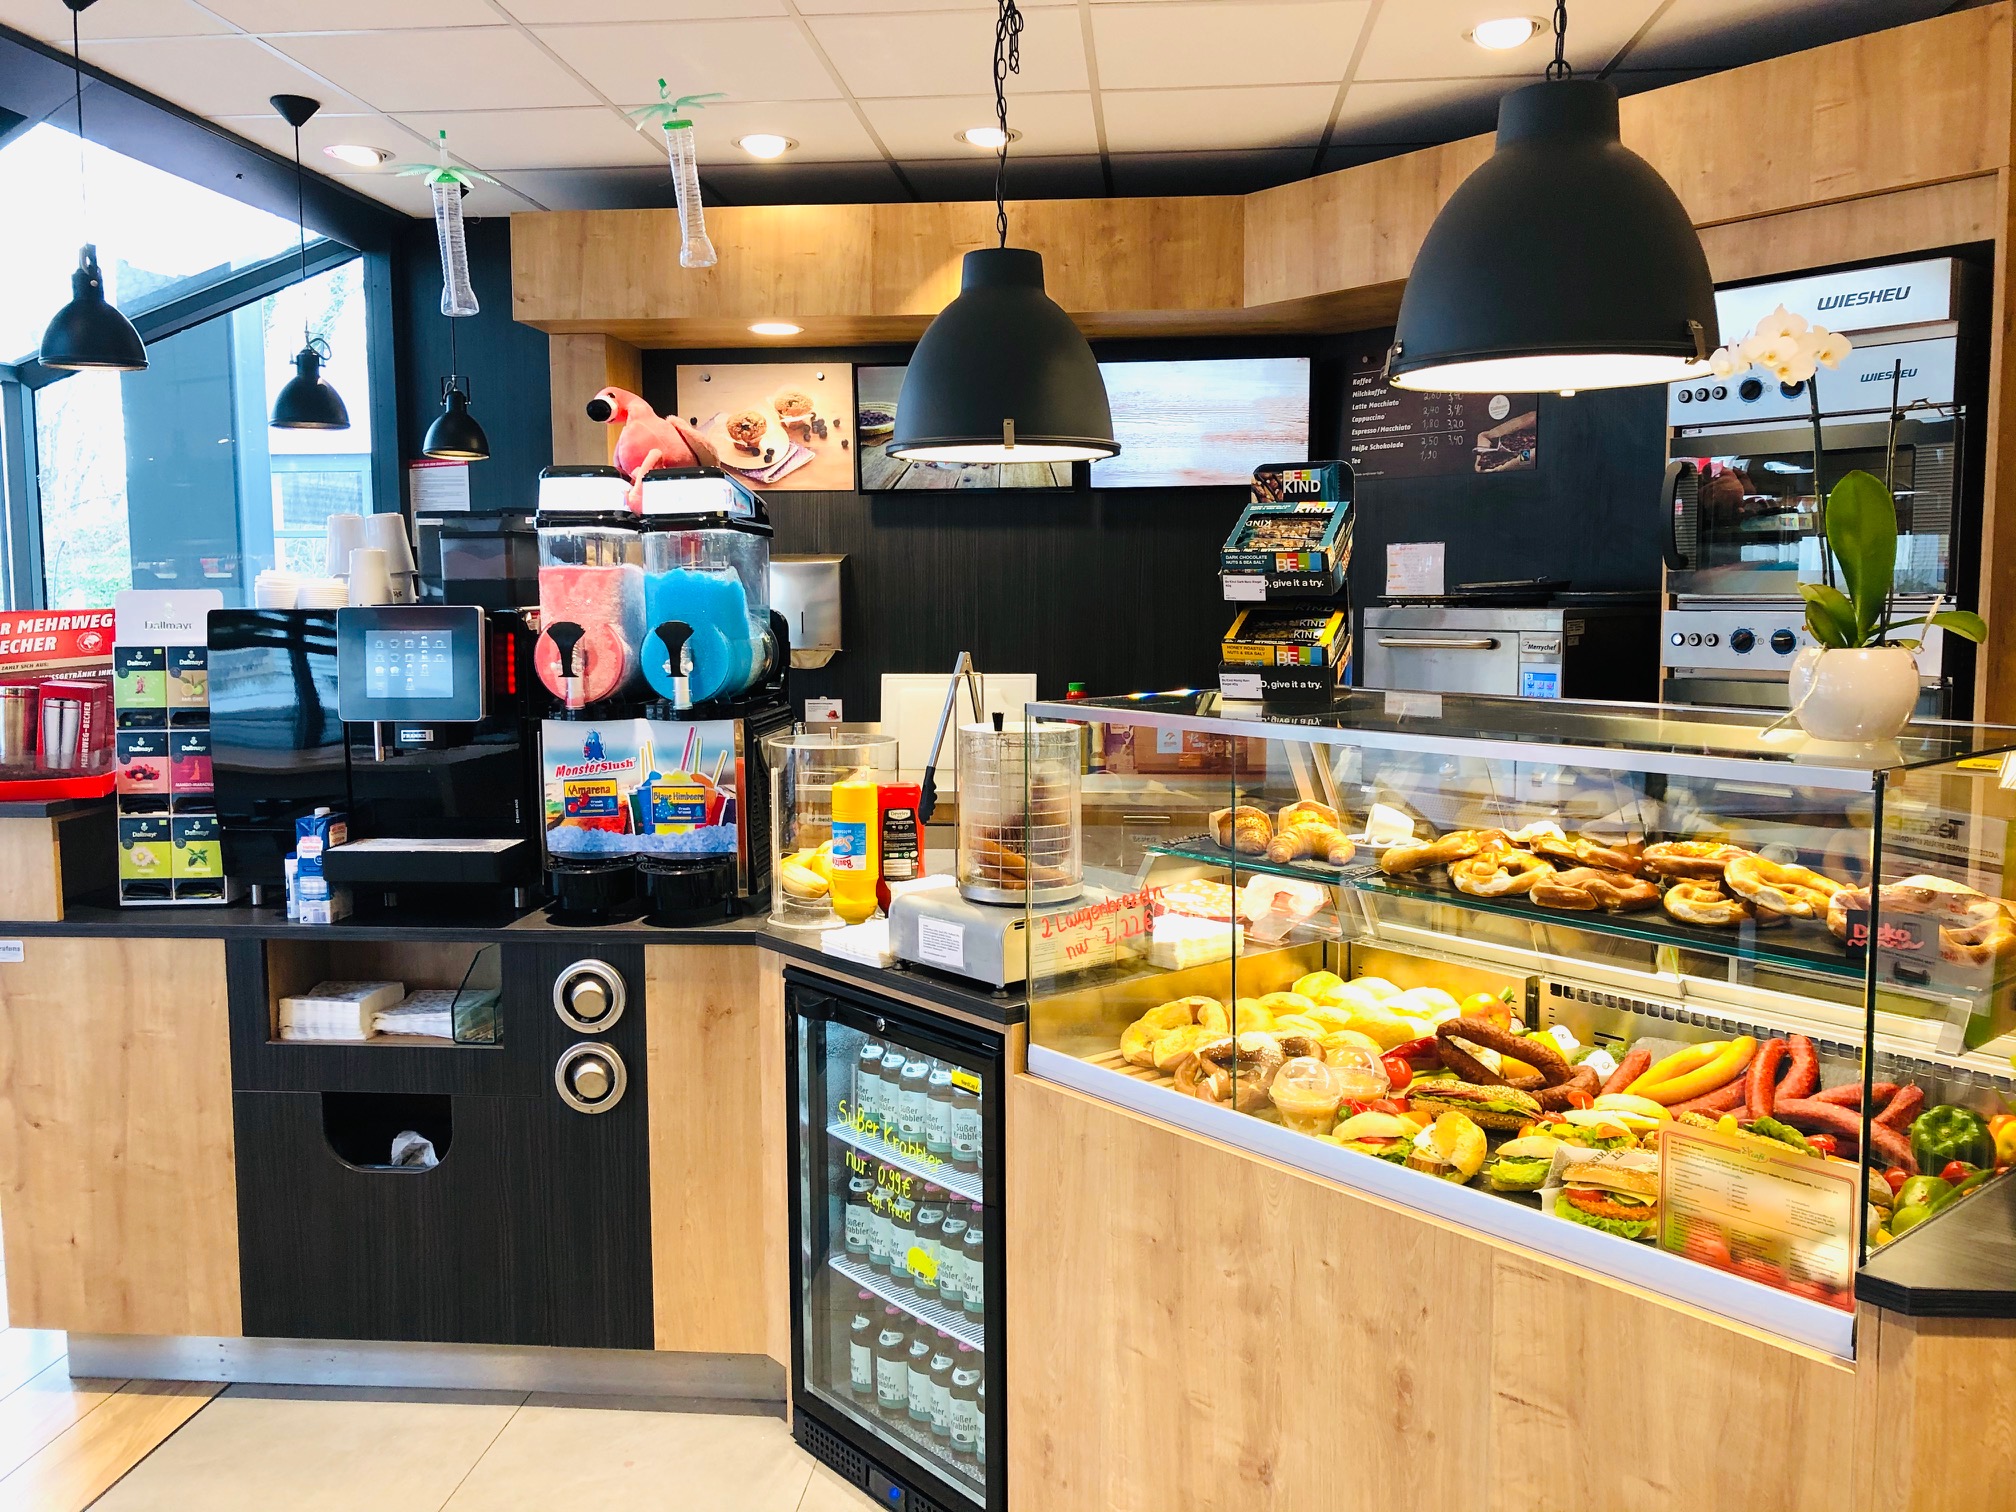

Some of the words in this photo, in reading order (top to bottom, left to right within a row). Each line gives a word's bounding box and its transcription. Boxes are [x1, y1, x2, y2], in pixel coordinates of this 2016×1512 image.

[1817, 286, 1911, 311] WIESHEU
[1352, 403, 1368, 411] Latte
[1369, 441, 1404, 451] Schokolade
[1283, 480, 1321, 494] KIND
[1276, 558, 1305, 571] BE-
[1273, 579, 1292, 588] give
[1310, 579, 1324, 588] try.
[144, 621, 192, 630] Dallmayr
[0, 637, 58, 654] ECHER
[1528, 643, 1556, 652] Merrychef
[1277, 651, 1305, 664] BE-
[39, 670, 97, 680] SSGETRÄNKE
[1271, 681, 1290, 690] give
[1291, 680, 1298, 688] it
[1307, 681, 1322, 689] try.
[81, 702, 91, 768] MEHRWEG-BECHER
[556, 760, 634, 777] MonsterSlush
[572, 785, 610, 795] Amarena
[654, 792, 672, 800] Blaue
[673, 792, 704, 800] Himbeere
[1041, 917, 1053, 938] 2
[1055, 884, 1165, 932] Laugenbrezeln
[1101, 909, 1156, 944] 2,22€
[838, 1099, 879, 1138] Süßer
[953, 1131, 977, 1140] Krabble
[878, 1165, 913, 1198] 0,99€
[887, 1197, 912, 1222] Pfand
[847, 1225, 869, 1235] rabbler
